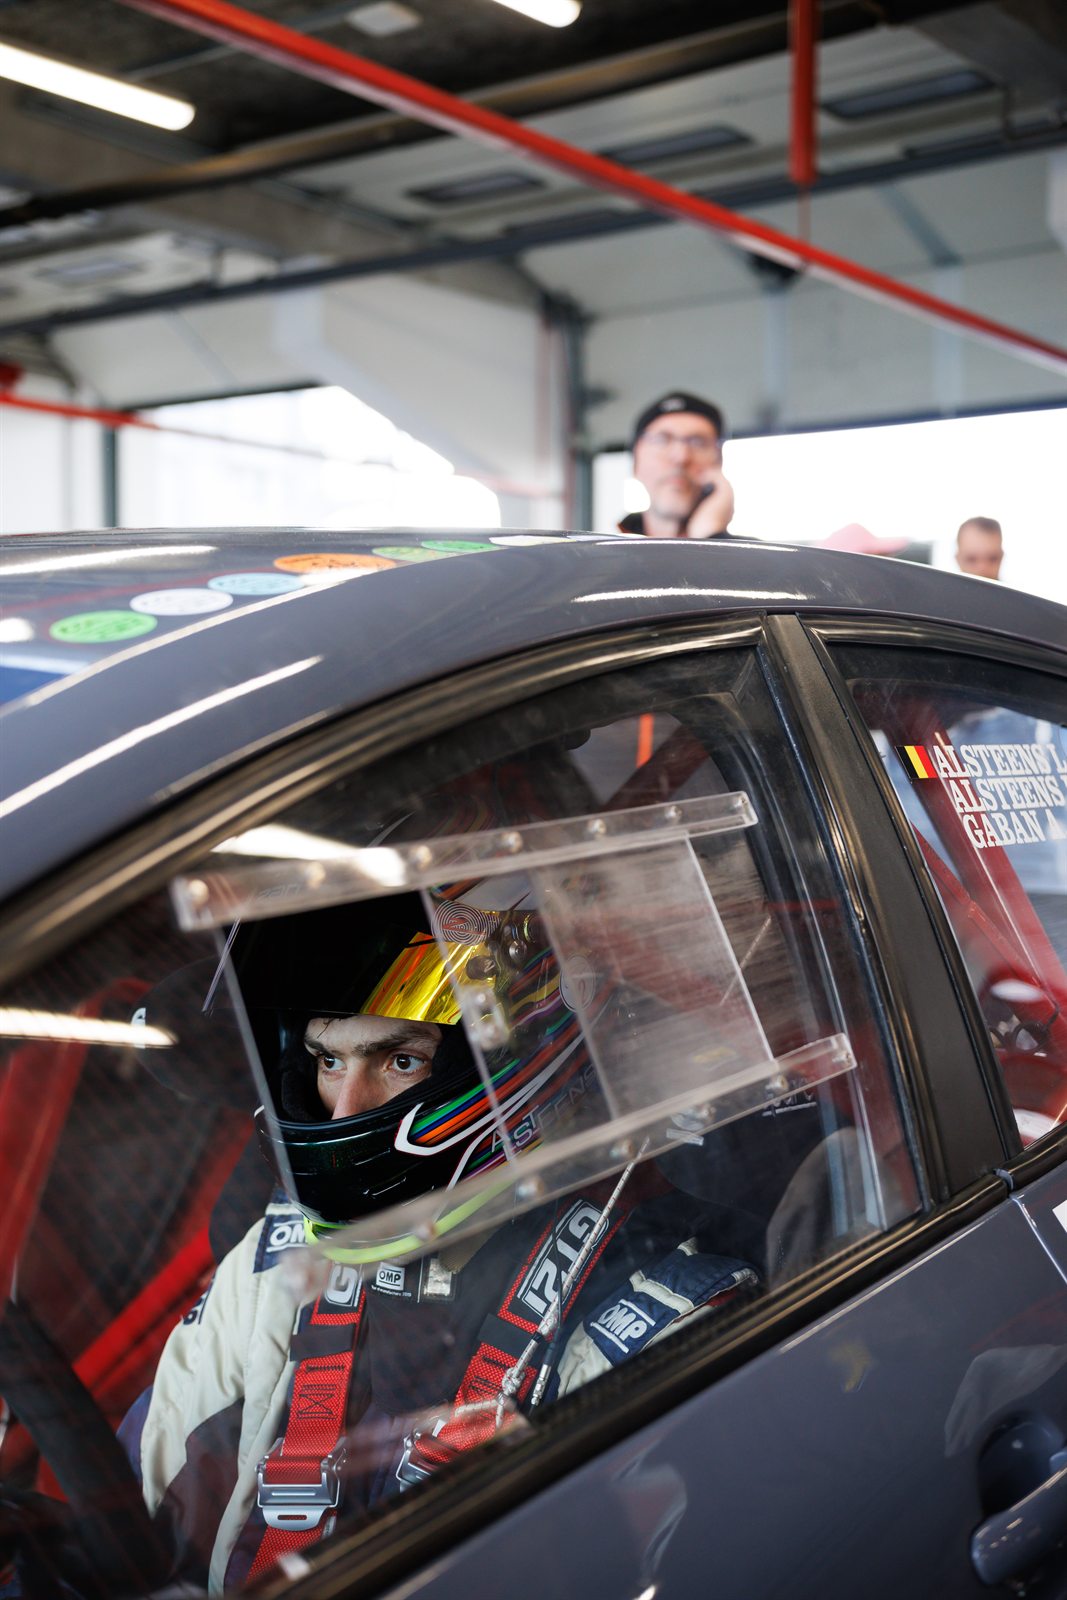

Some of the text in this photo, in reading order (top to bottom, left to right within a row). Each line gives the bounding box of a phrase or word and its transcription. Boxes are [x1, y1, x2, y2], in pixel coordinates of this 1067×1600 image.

[933, 744, 1052, 778] ALSTEENS
[949, 775, 1066, 813] ALSTEENS
[963, 810, 1046, 849] GABAN
[270, 1223, 307, 1246] OM
[378, 1270, 401, 1284] OMP
[598, 1304, 648, 1341] OMP
